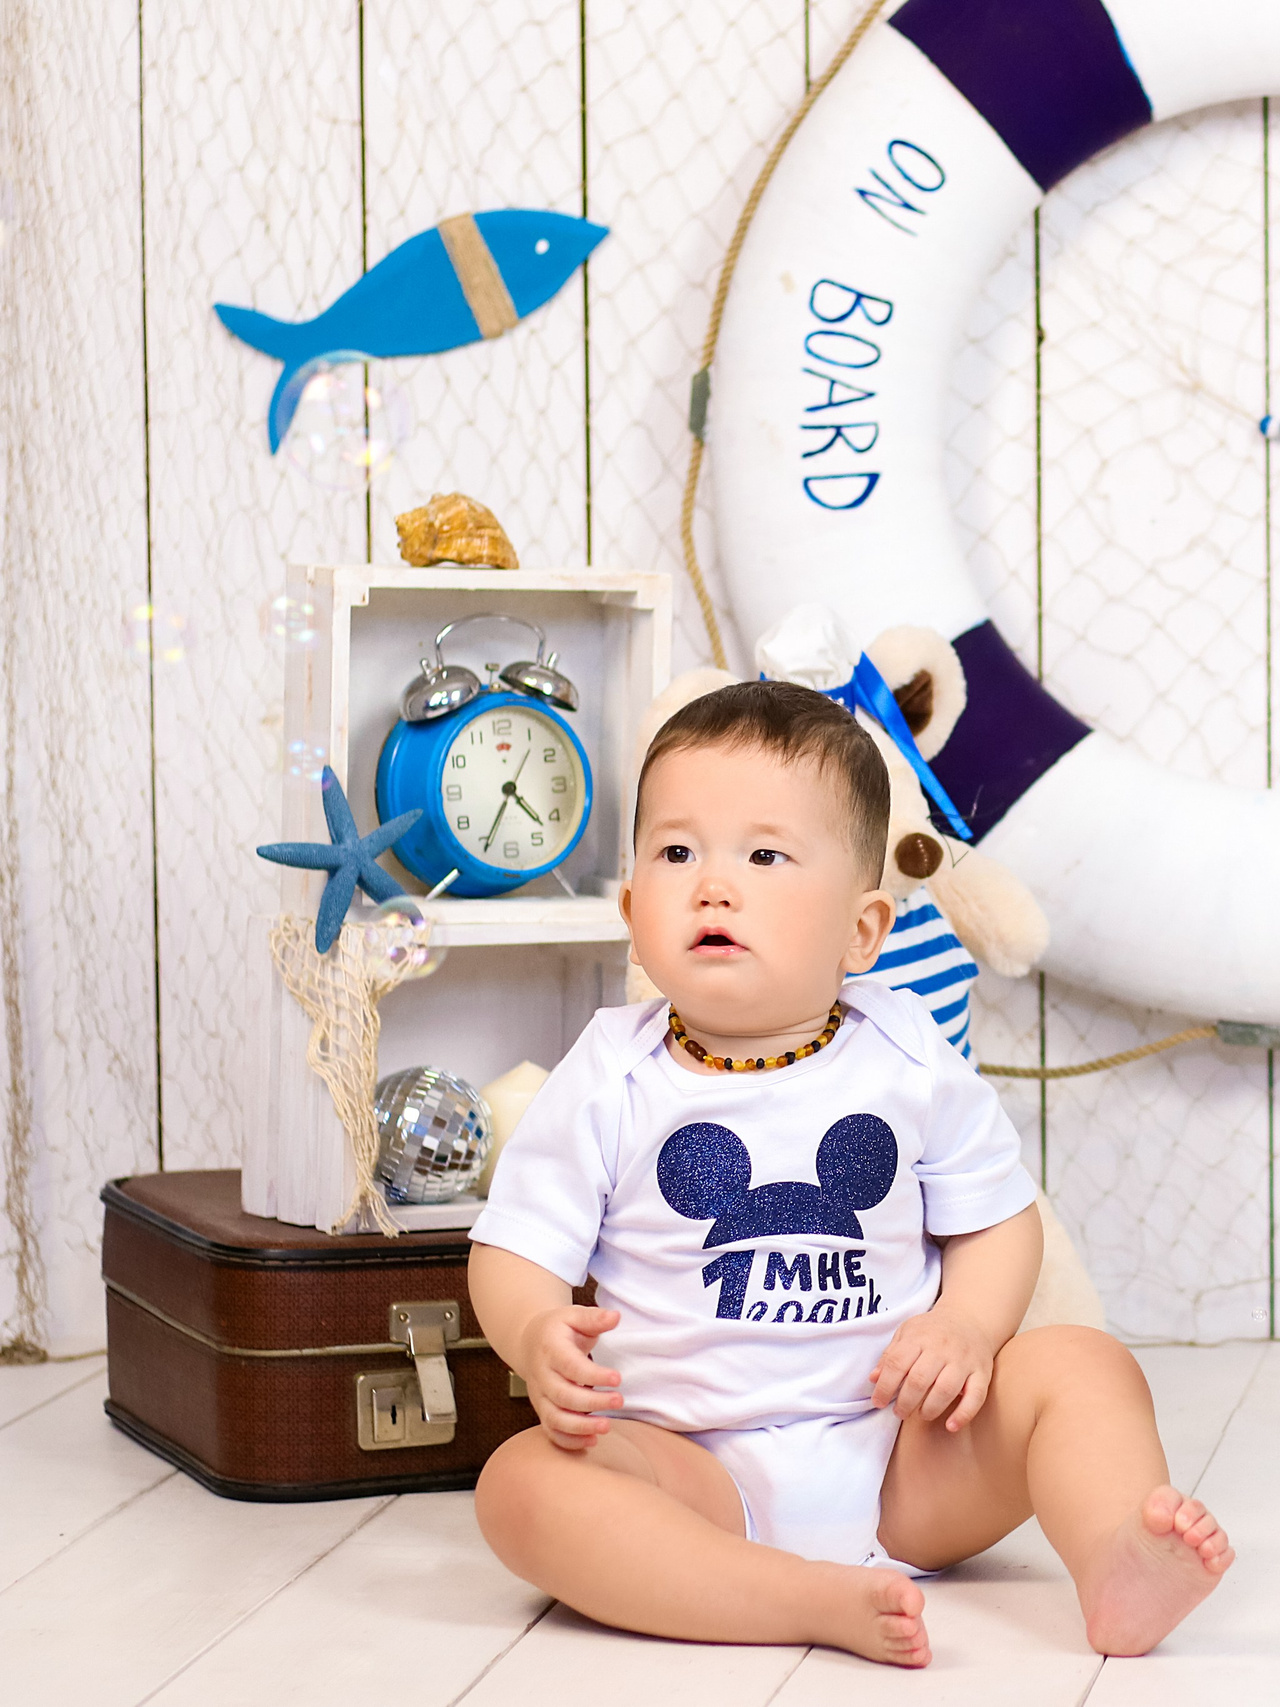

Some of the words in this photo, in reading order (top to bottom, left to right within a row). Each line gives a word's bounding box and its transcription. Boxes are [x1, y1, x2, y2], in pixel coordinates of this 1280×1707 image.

[853, 139, 946, 237] ON
[800, 278, 894, 511] BOARD
[492, 719, 512, 736] 12
[470, 730, 483, 745] 11
[451, 754, 466, 769] 10
[543, 748, 556, 763] 2
[446, 784, 462, 801] 9
[551, 776, 567, 793] 3
[457, 815, 470, 830] 8
[548, 808, 561, 822] 4
[531, 832, 544, 847] 5
[503, 841, 520, 858] 6
[702, 1249, 756, 1321] 1
